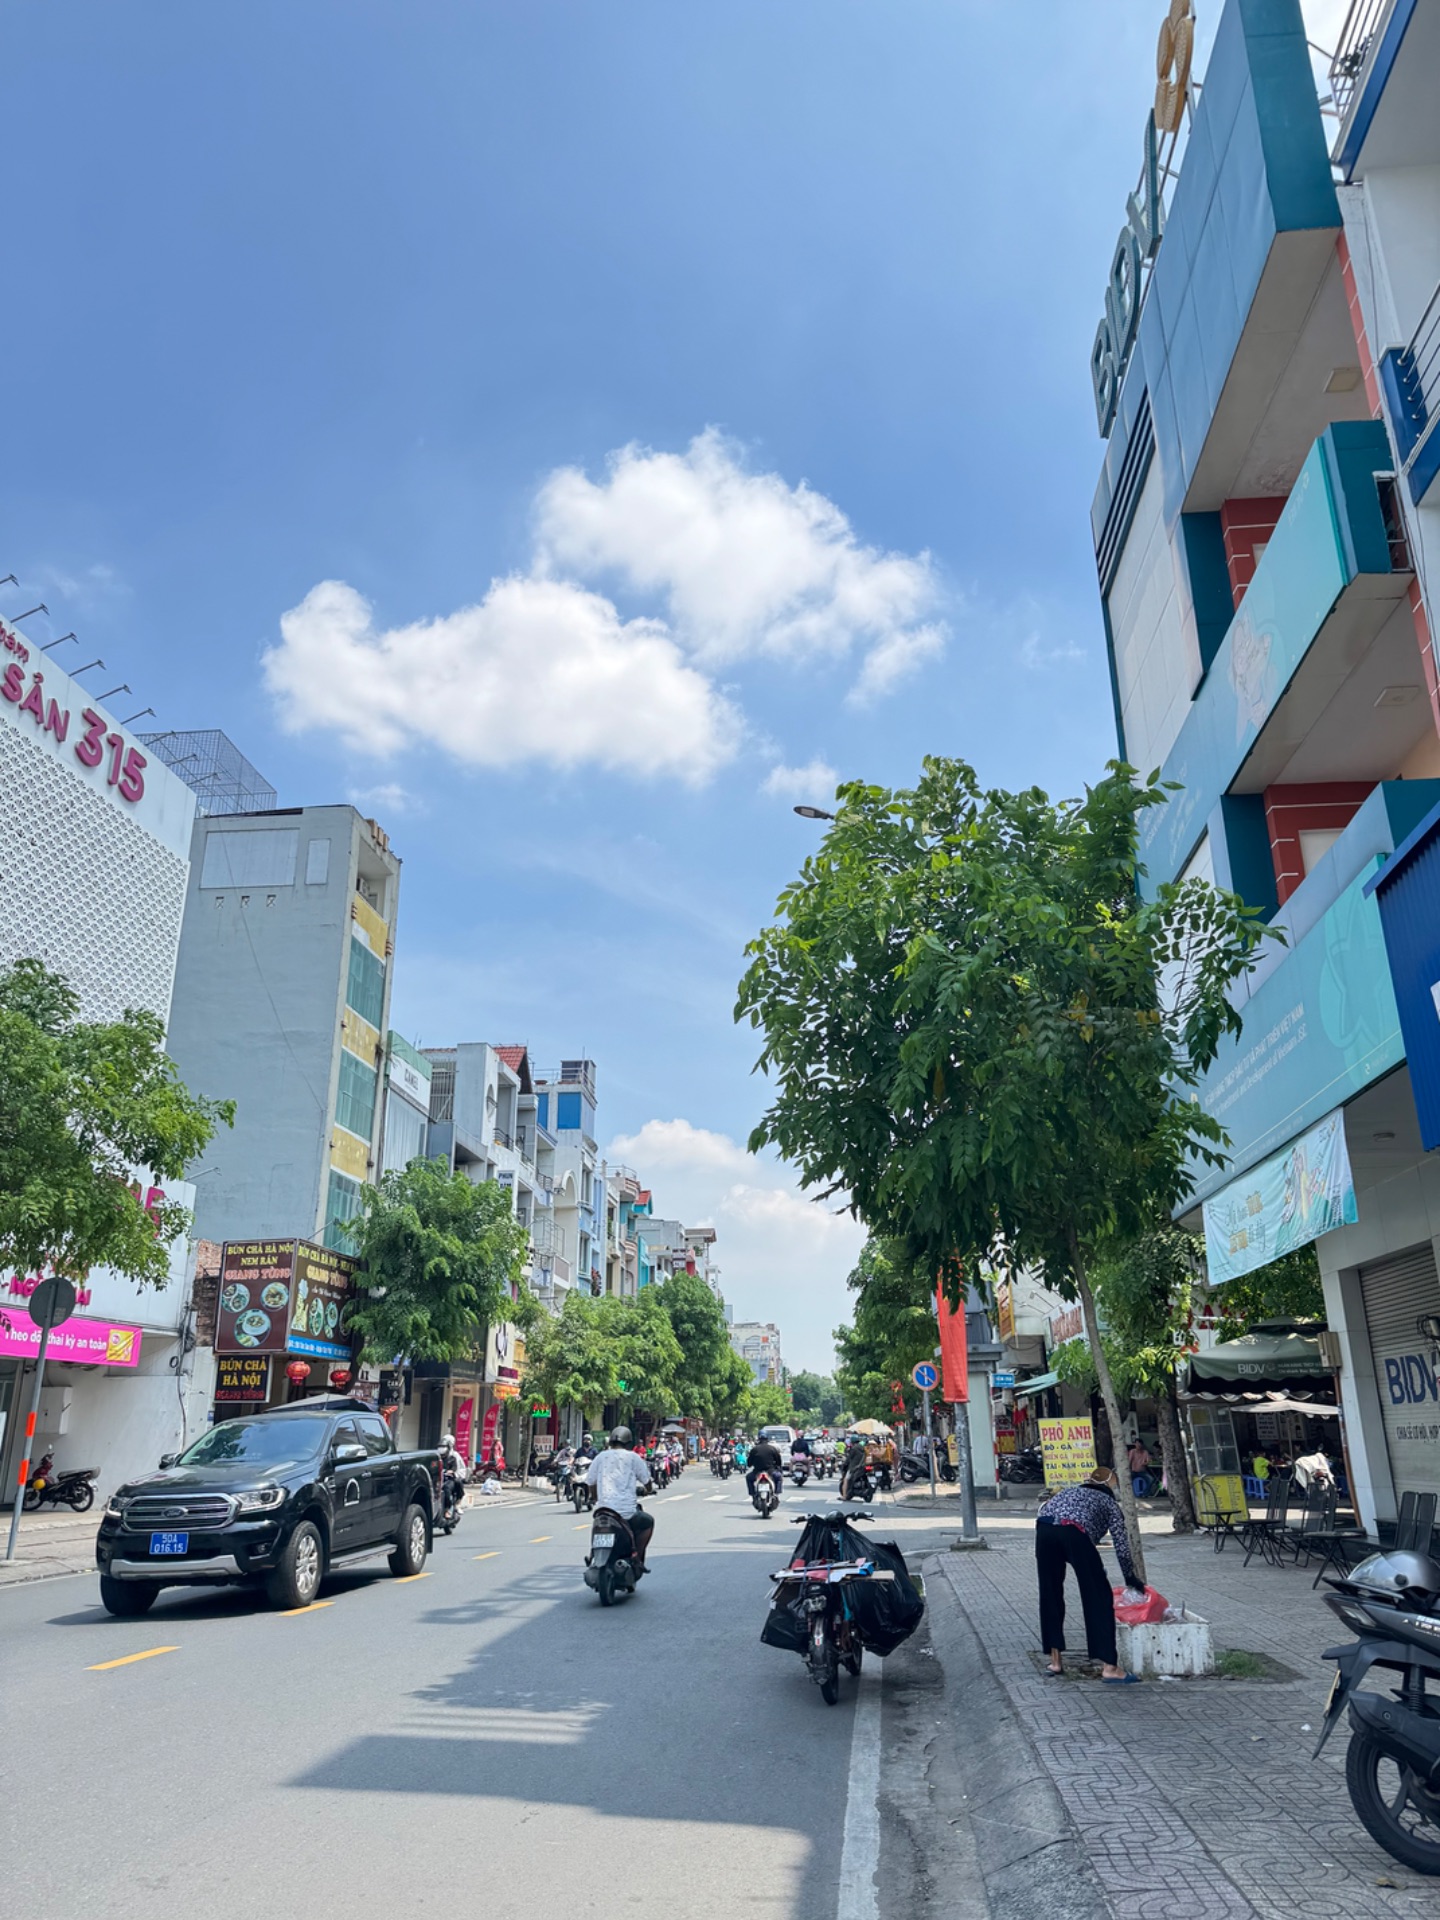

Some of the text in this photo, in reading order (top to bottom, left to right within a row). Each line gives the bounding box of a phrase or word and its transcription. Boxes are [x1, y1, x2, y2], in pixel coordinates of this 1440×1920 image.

[1, 663, 148, 803] SẢN 315
[227, 1244, 245, 1255] BÚN
[246, 1242, 263, 1255] CHẢ
[265, 1242, 278, 1253] HÀ
[241, 1255, 279, 1266] NEM RÁN
[225, 1265, 292, 1280] GIANG TÙNG
[30, 1329, 42, 1342] dõ
[77, 1339, 88, 1347] an
[89, 1338, 107, 1350] toàn
[220, 1356, 267, 1371] BÚN CHẢ
[1238, 1363, 1265, 1375] BIDV
[222, 1371, 262, 1388] HÀ NỘI
[1385, 1353, 1438, 1405] BIDV
[1041, 1421, 1092, 1441] PHỞ ANH
[1044, 1443, 1055, 1451] BÒ
[1060, 1442, 1072, 1450] GÀ
[162, 1534, 178, 1544] 50A
[154, 1542, 184, 1553] 016.15
